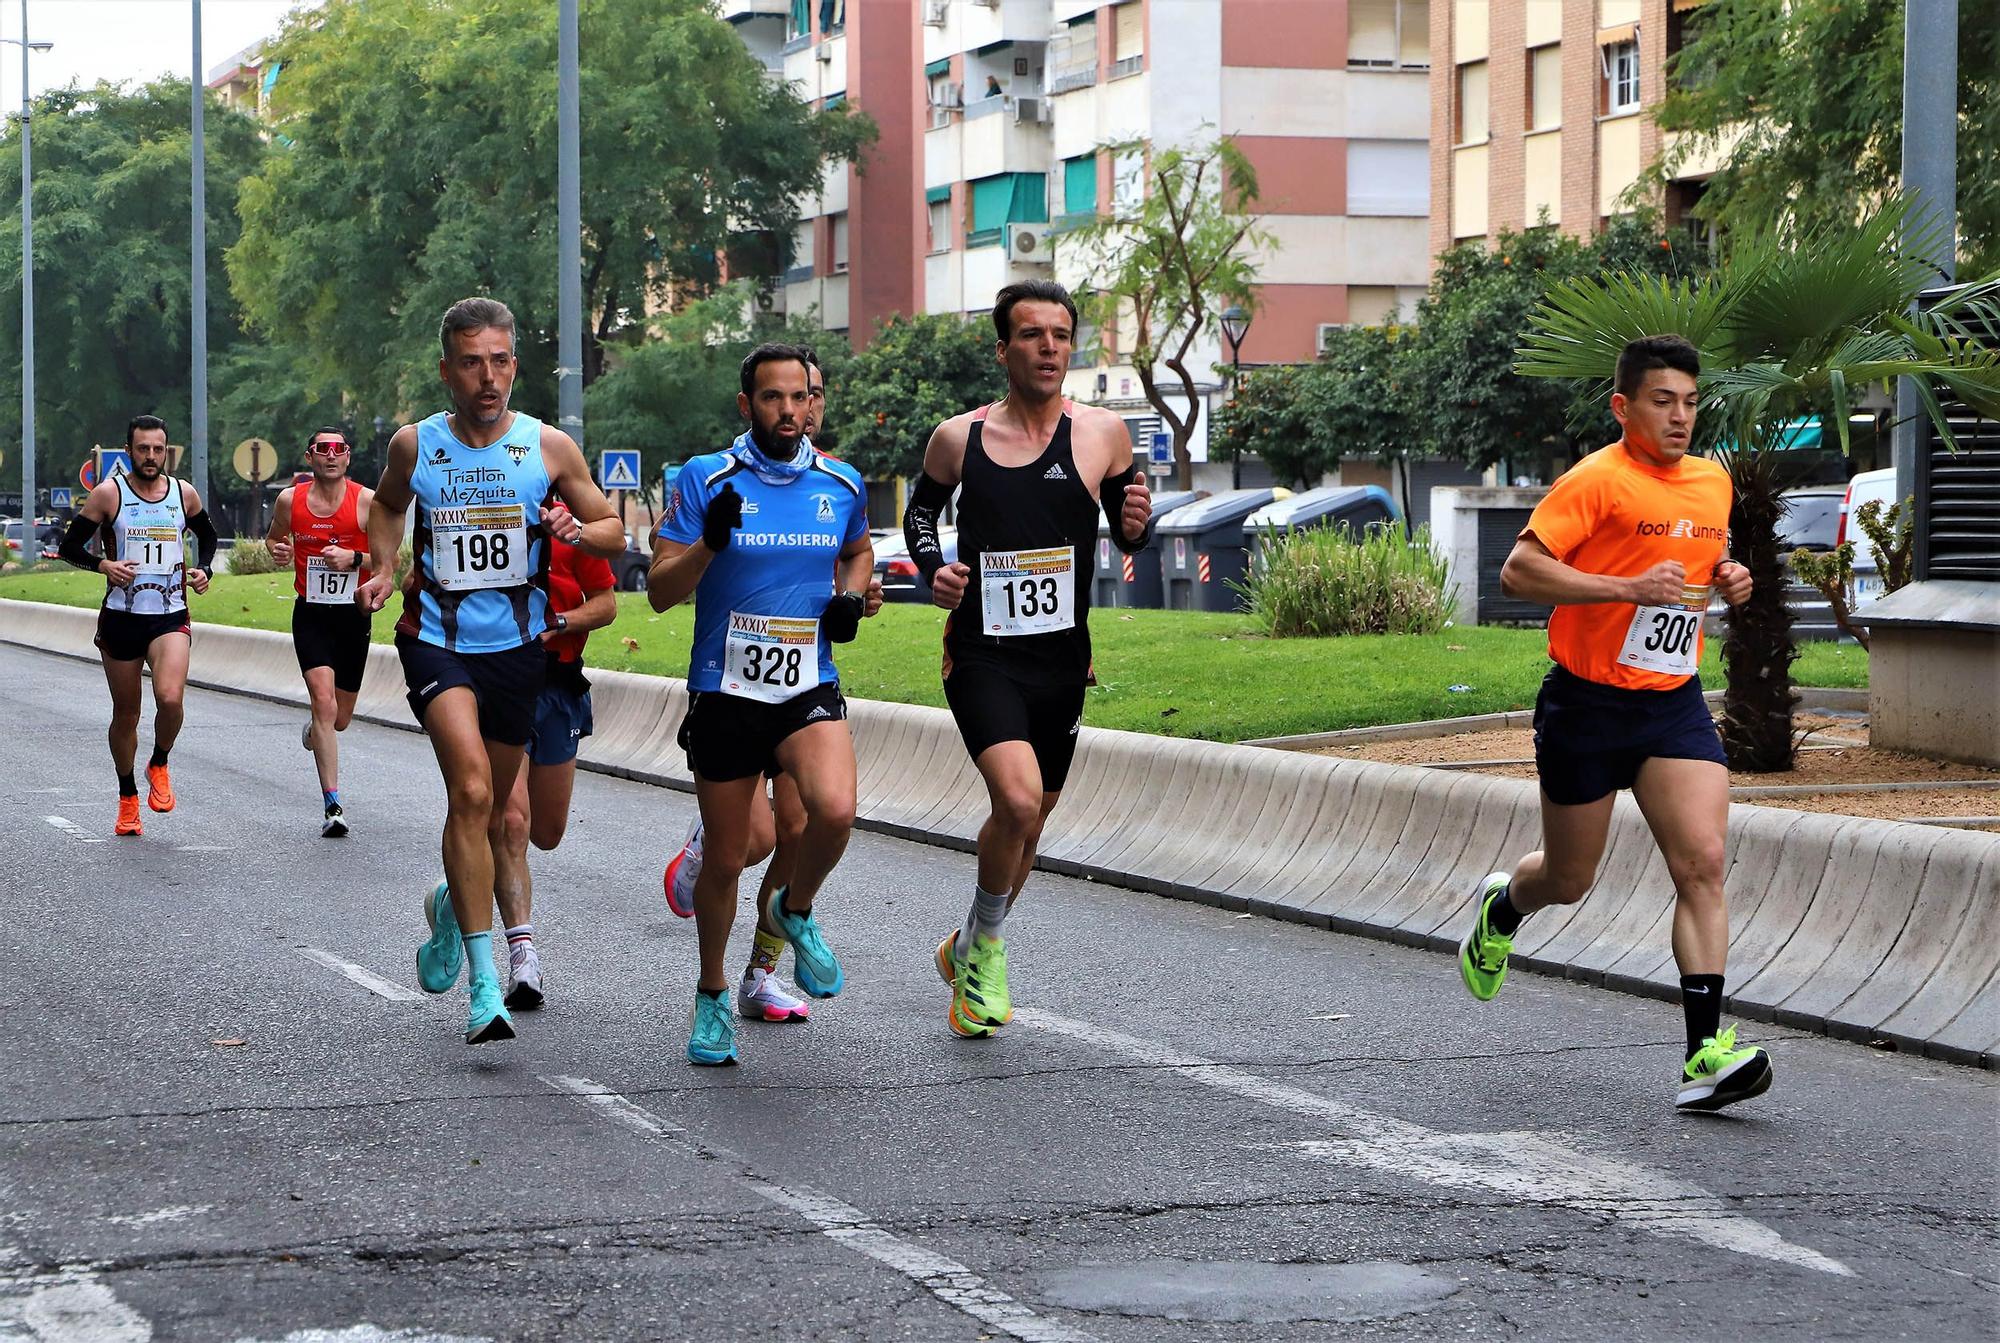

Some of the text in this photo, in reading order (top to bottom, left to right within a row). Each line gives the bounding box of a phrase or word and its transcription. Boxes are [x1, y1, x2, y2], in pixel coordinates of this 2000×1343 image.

[433, 509, 467, 525] XXXIX
[482, 522, 522, 530] TRINITARIOS
[128, 528, 148, 537] XXXIX
[735, 532, 839, 548] TROTASIERRA
[143, 542, 163, 565] 11
[452, 532, 510, 573] 198
[984, 555, 1017, 570] XXXIX
[1033, 565, 1071, 575] TRINITARIOS
[318, 572, 349, 595] 157
[1002, 577, 1059, 618] 133
[733, 615, 768, 634] XXXIX
[1644, 611, 1698, 657] 308
[743, 644, 802, 687] 328
